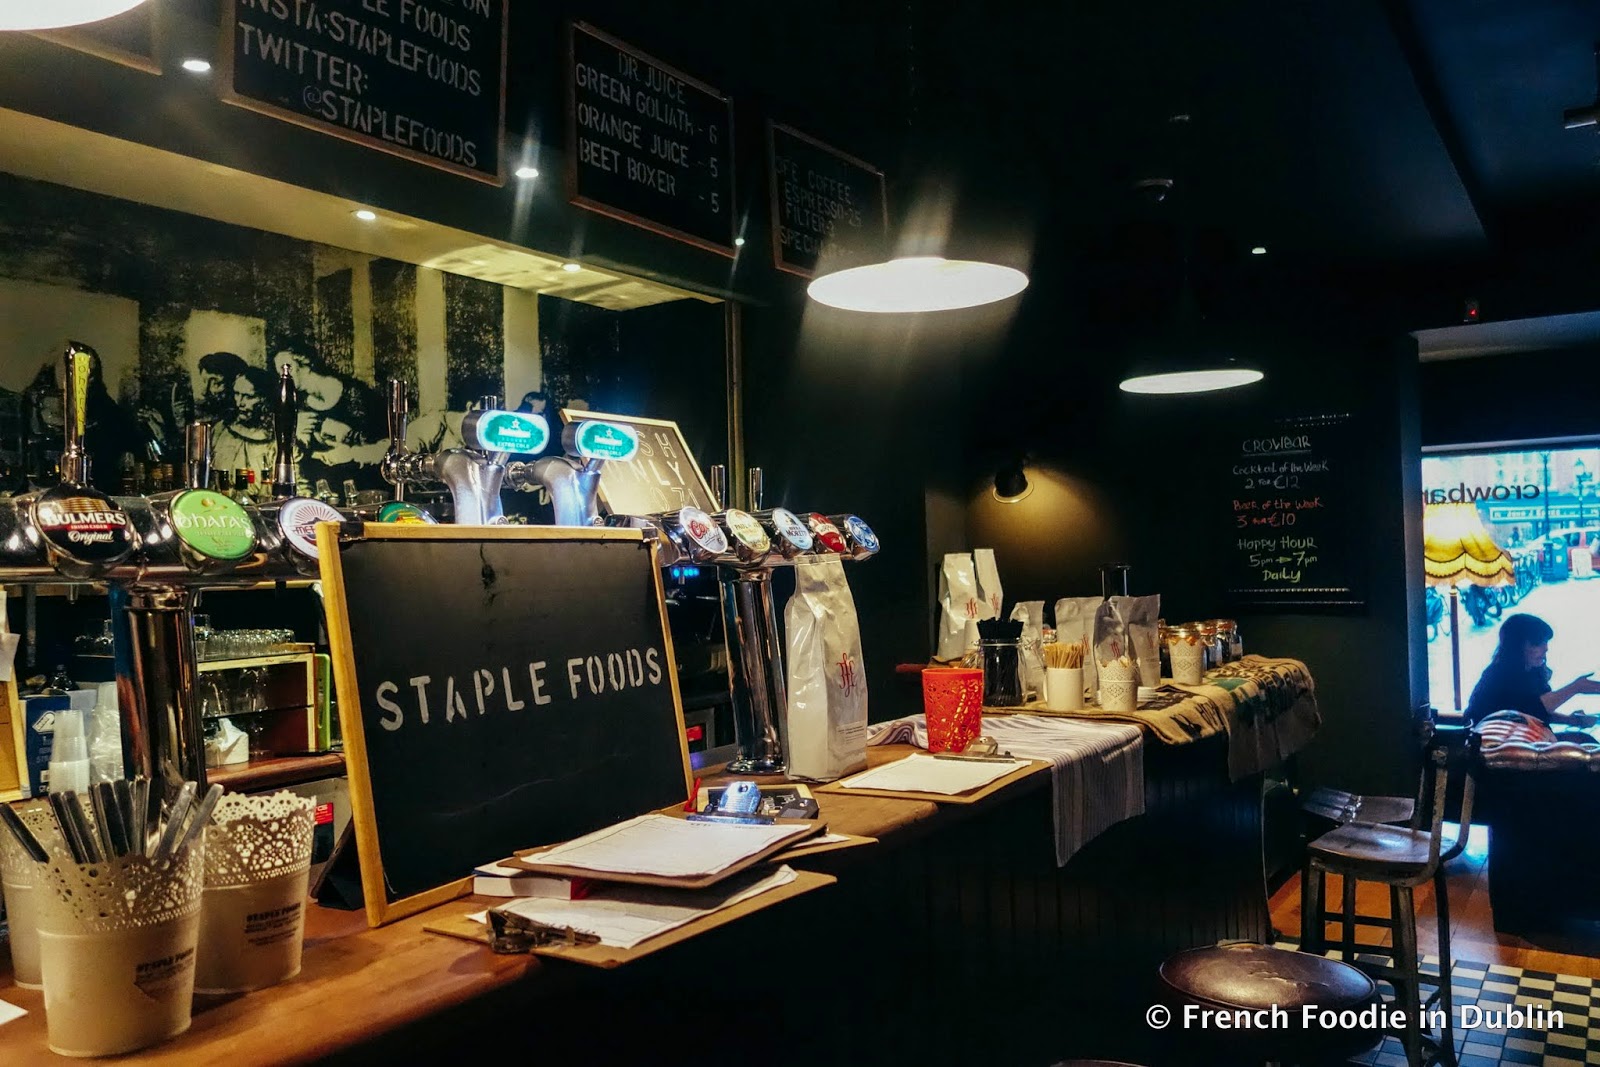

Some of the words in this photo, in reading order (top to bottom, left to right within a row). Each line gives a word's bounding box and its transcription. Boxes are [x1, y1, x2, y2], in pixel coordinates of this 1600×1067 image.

[238, 21, 369, 94] TWITTER:
[645, 66, 686, 105] JUICE
[303, 85, 477, 168] @STAPLEFOODS
[575, 62, 631, 106] GREEN
[636, 91, 694, 136] GOLIATH
[578, 102, 642, 149] ORANGE
[650, 134, 690, 168] JUICE
[709, 156, 719, 178] 5
[579, 136, 621, 174] BEET
[627, 156, 676, 196] BOXER
[710, 192, 720, 213] 5
[1244, 479, 1255, 489] 2
[67, 530, 114, 546] Original
[1236, 515, 1248, 528] 3
[1248, 553, 1274, 567] 5pm
[1292, 551, 1318, 567] 7pm
[375, 661, 551, 731] STAPLE
[567, 647, 662, 699] FOODS
